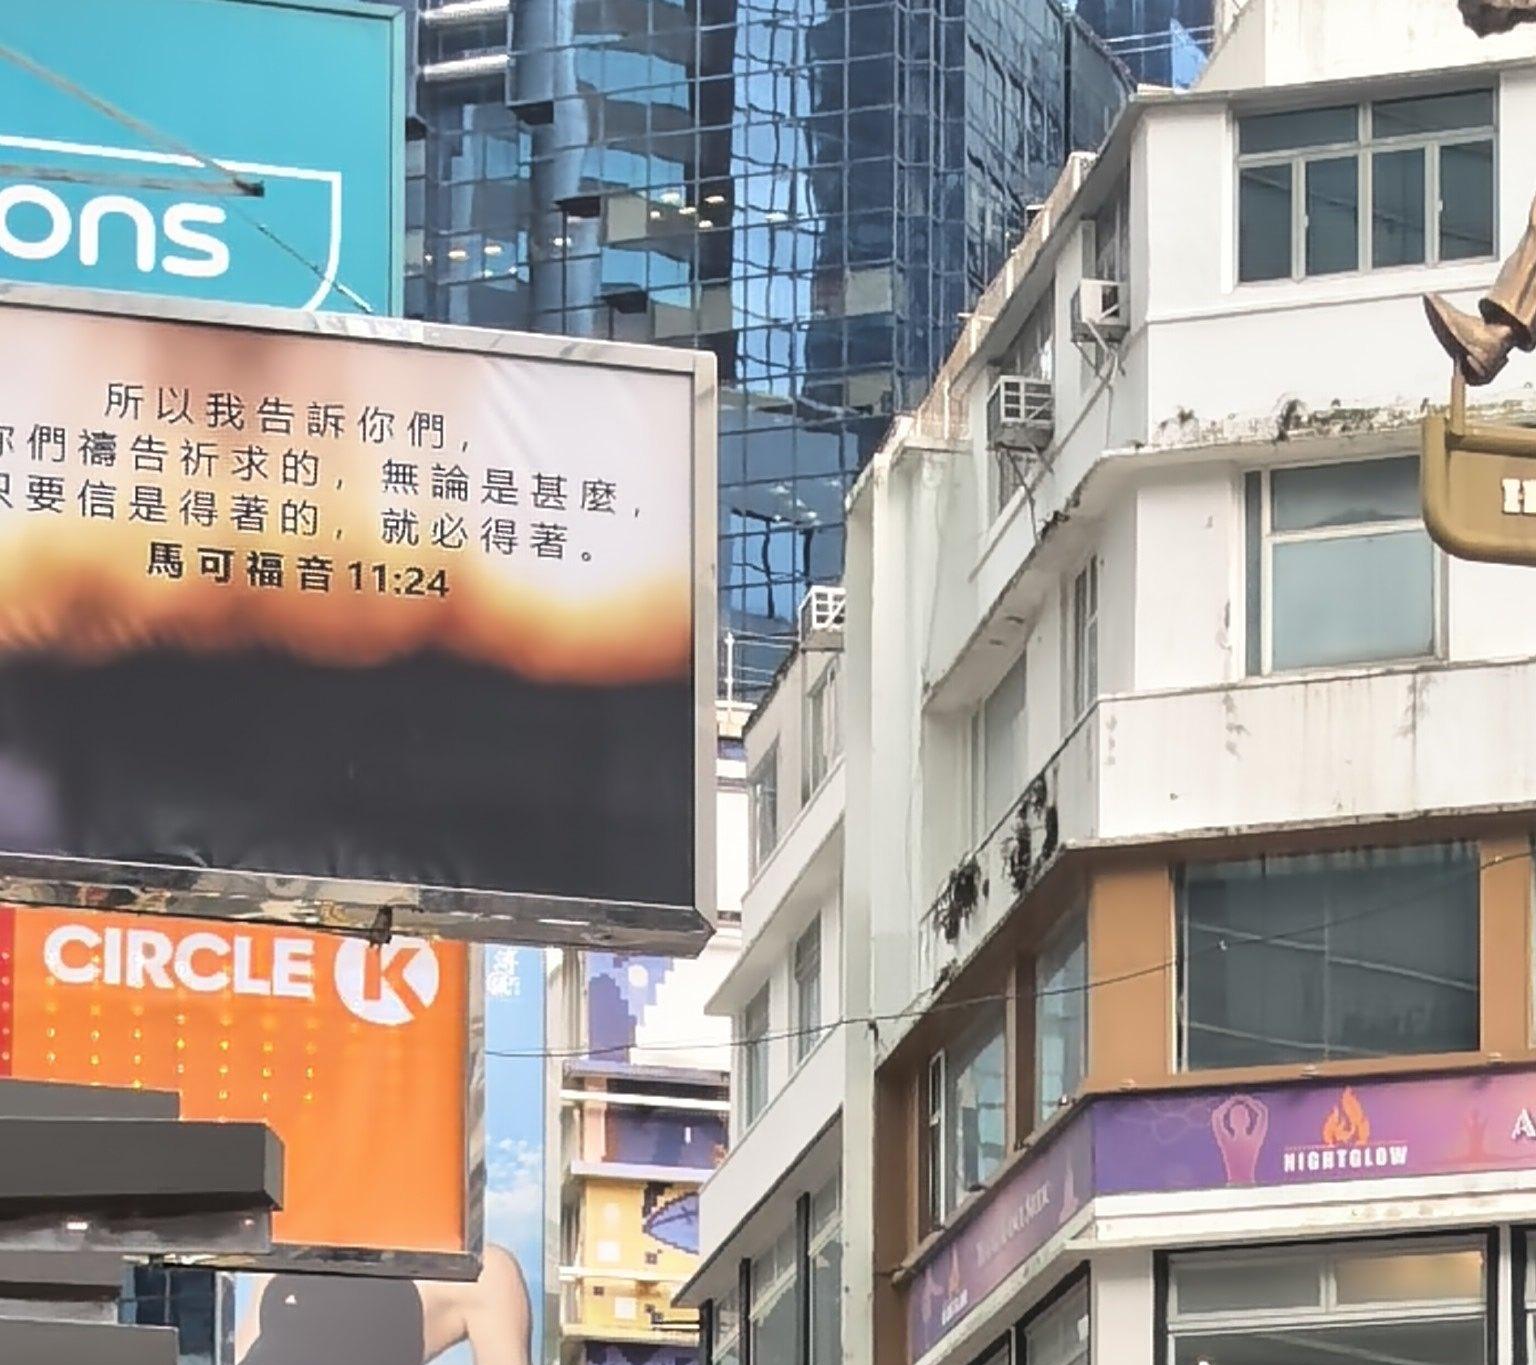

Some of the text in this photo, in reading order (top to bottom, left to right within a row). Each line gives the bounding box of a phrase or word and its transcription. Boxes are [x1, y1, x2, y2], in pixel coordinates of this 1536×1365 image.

[147, 541, 450, 598] 馬可福音 11:24
[43, 924, 316, 1000] CIRCLE
[334, 933, 441, 1026] K
[1283, 1146, 1408, 1172] NIGHTGLOW
